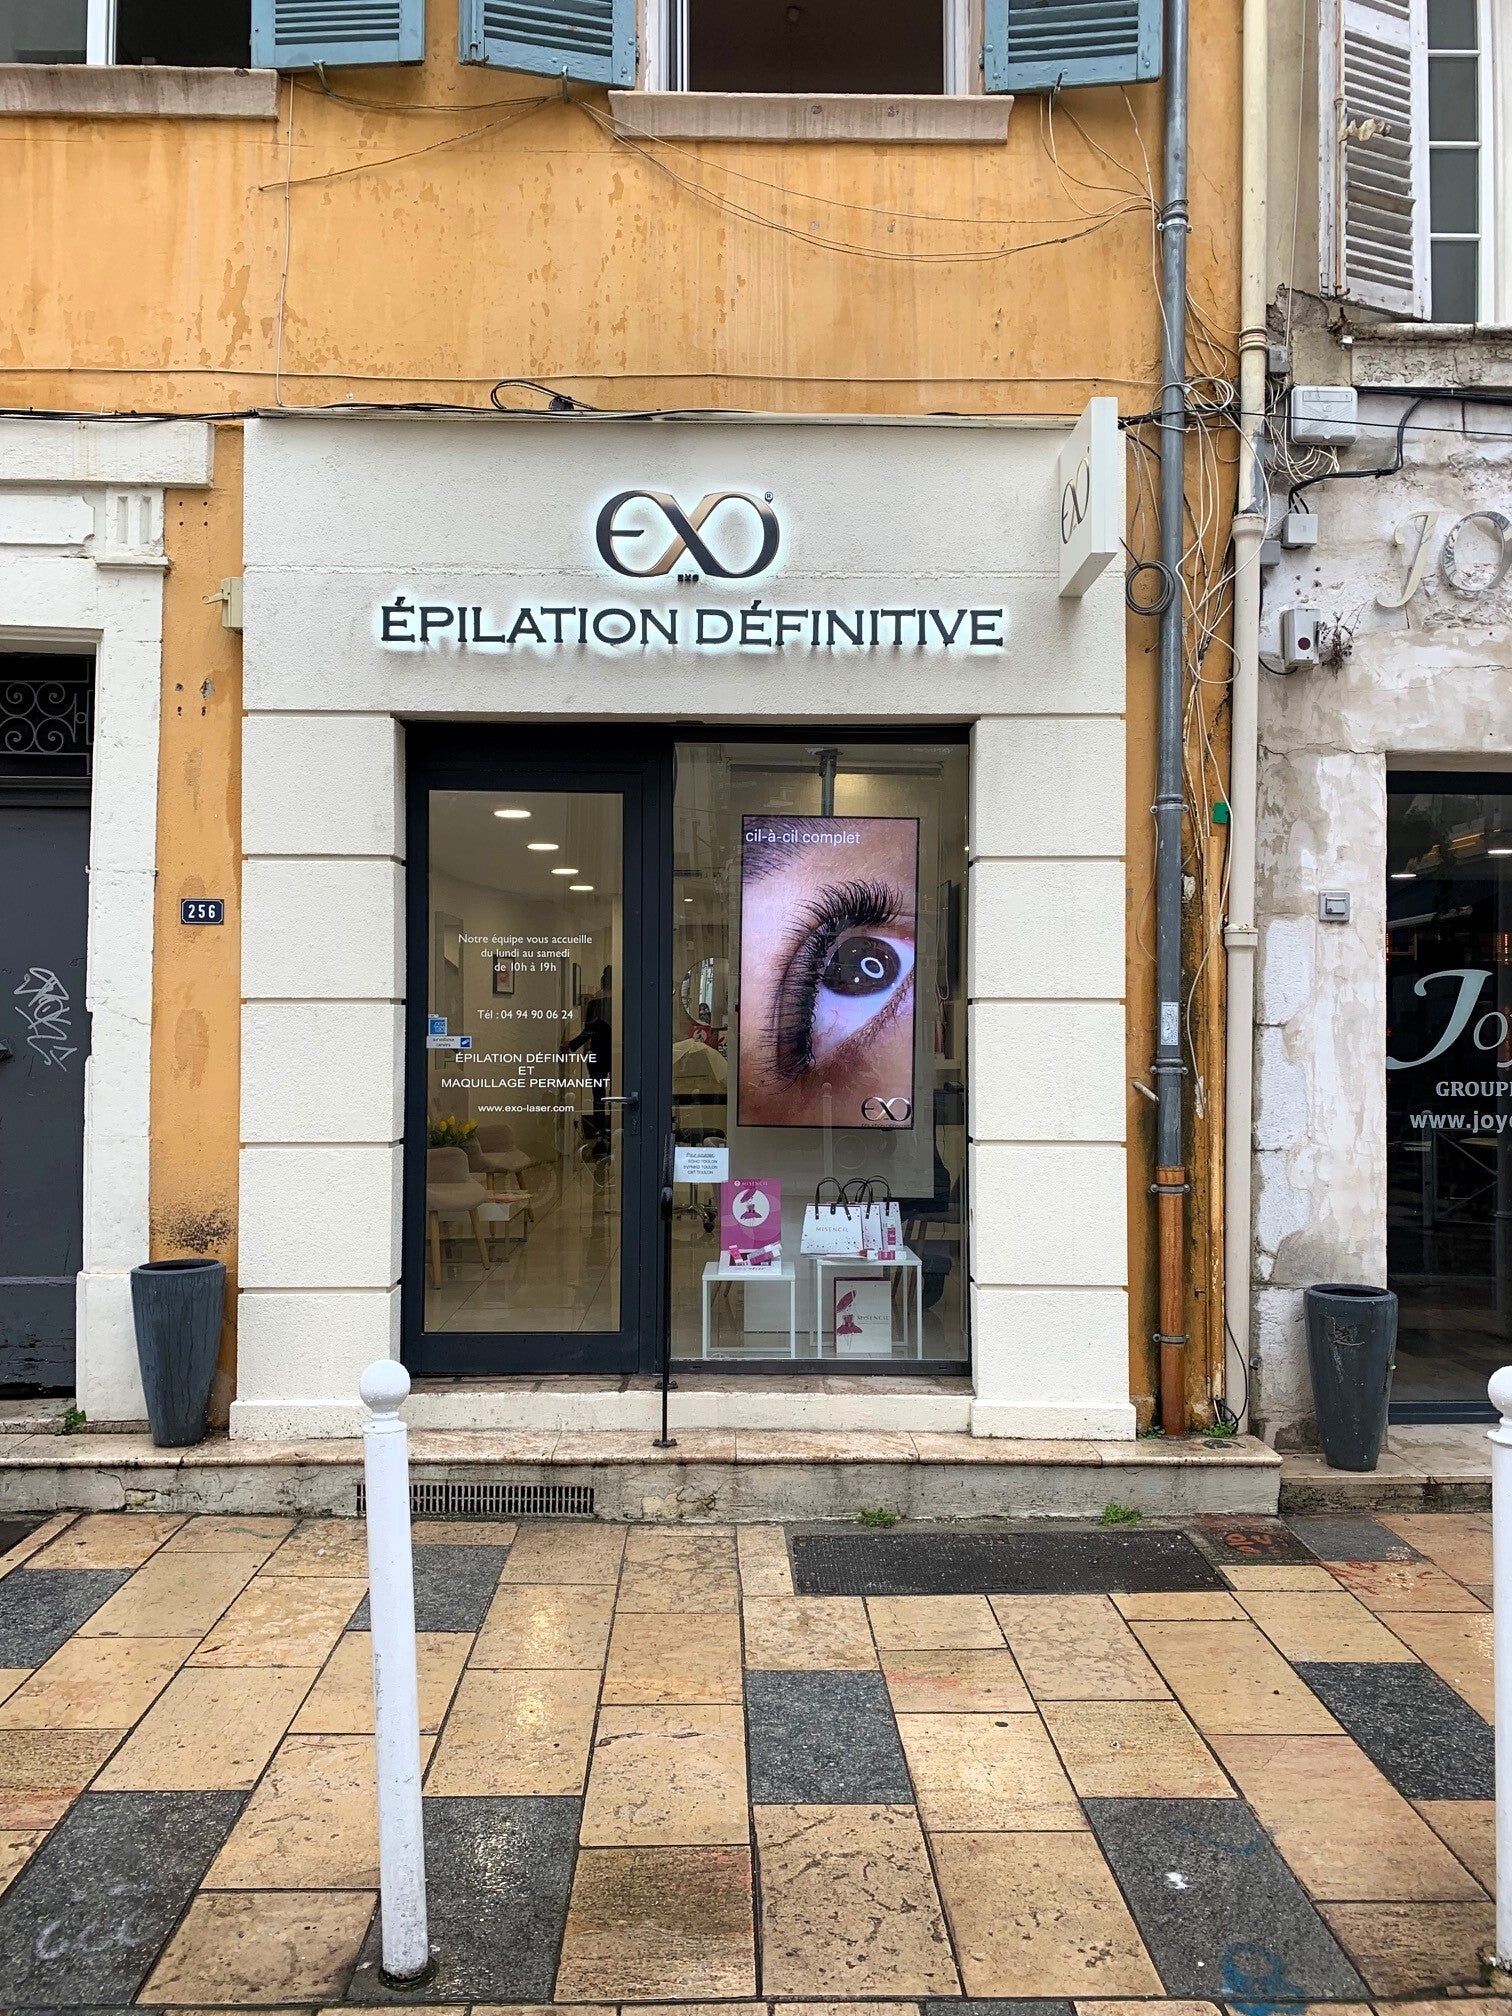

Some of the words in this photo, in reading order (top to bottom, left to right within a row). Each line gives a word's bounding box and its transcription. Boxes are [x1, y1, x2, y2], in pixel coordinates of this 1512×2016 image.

[380, 596, 679, 645] ÉPILATION
[695, 600, 1003, 648] DÉFINITIVE
[745, 829, 798, 843] cil-à-cil
[802, 830, 861, 847] complet
[188, 904, 216, 919] 256
[458, 934, 488, 944] Notre
[491, 934, 523, 946] équipe
[527, 936, 549, 944] vous
[551, 934, 592, 944] accueille
[481, 949, 493, 958] du
[496, 949, 520, 958] lundi
[536, 949, 570, 958] samedi
[494, 962, 507, 972] de
[510, 962, 527, 972] 10h
[530, 962, 536, 972] à
[540, 962, 557, 972] 19h
[477, 1010, 493, 1020] Tél
[516, 1010, 528, 1020] 94
[531, 1010, 544, 1020] 90
[546, 1010, 559, 1020] 06
[561, 1010, 574, 1020] 24
[1386, 969, 1512, 1070] Jo
[455, 1052, 522, 1063] ÉPILATION
[526, 1052, 597, 1063] DÉFINITIVE
[518, 1066, 535, 1075] ET
[441, 1078, 526, 1088] MAQUILLAGE
[530, 1078, 611, 1088] PERMANENT
[1435, 1081, 1512, 1097] GROUP
[478, 1104, 575, 1112] www.exo-laser.com
[1409, 1110, 1512, 1134] www.joy
